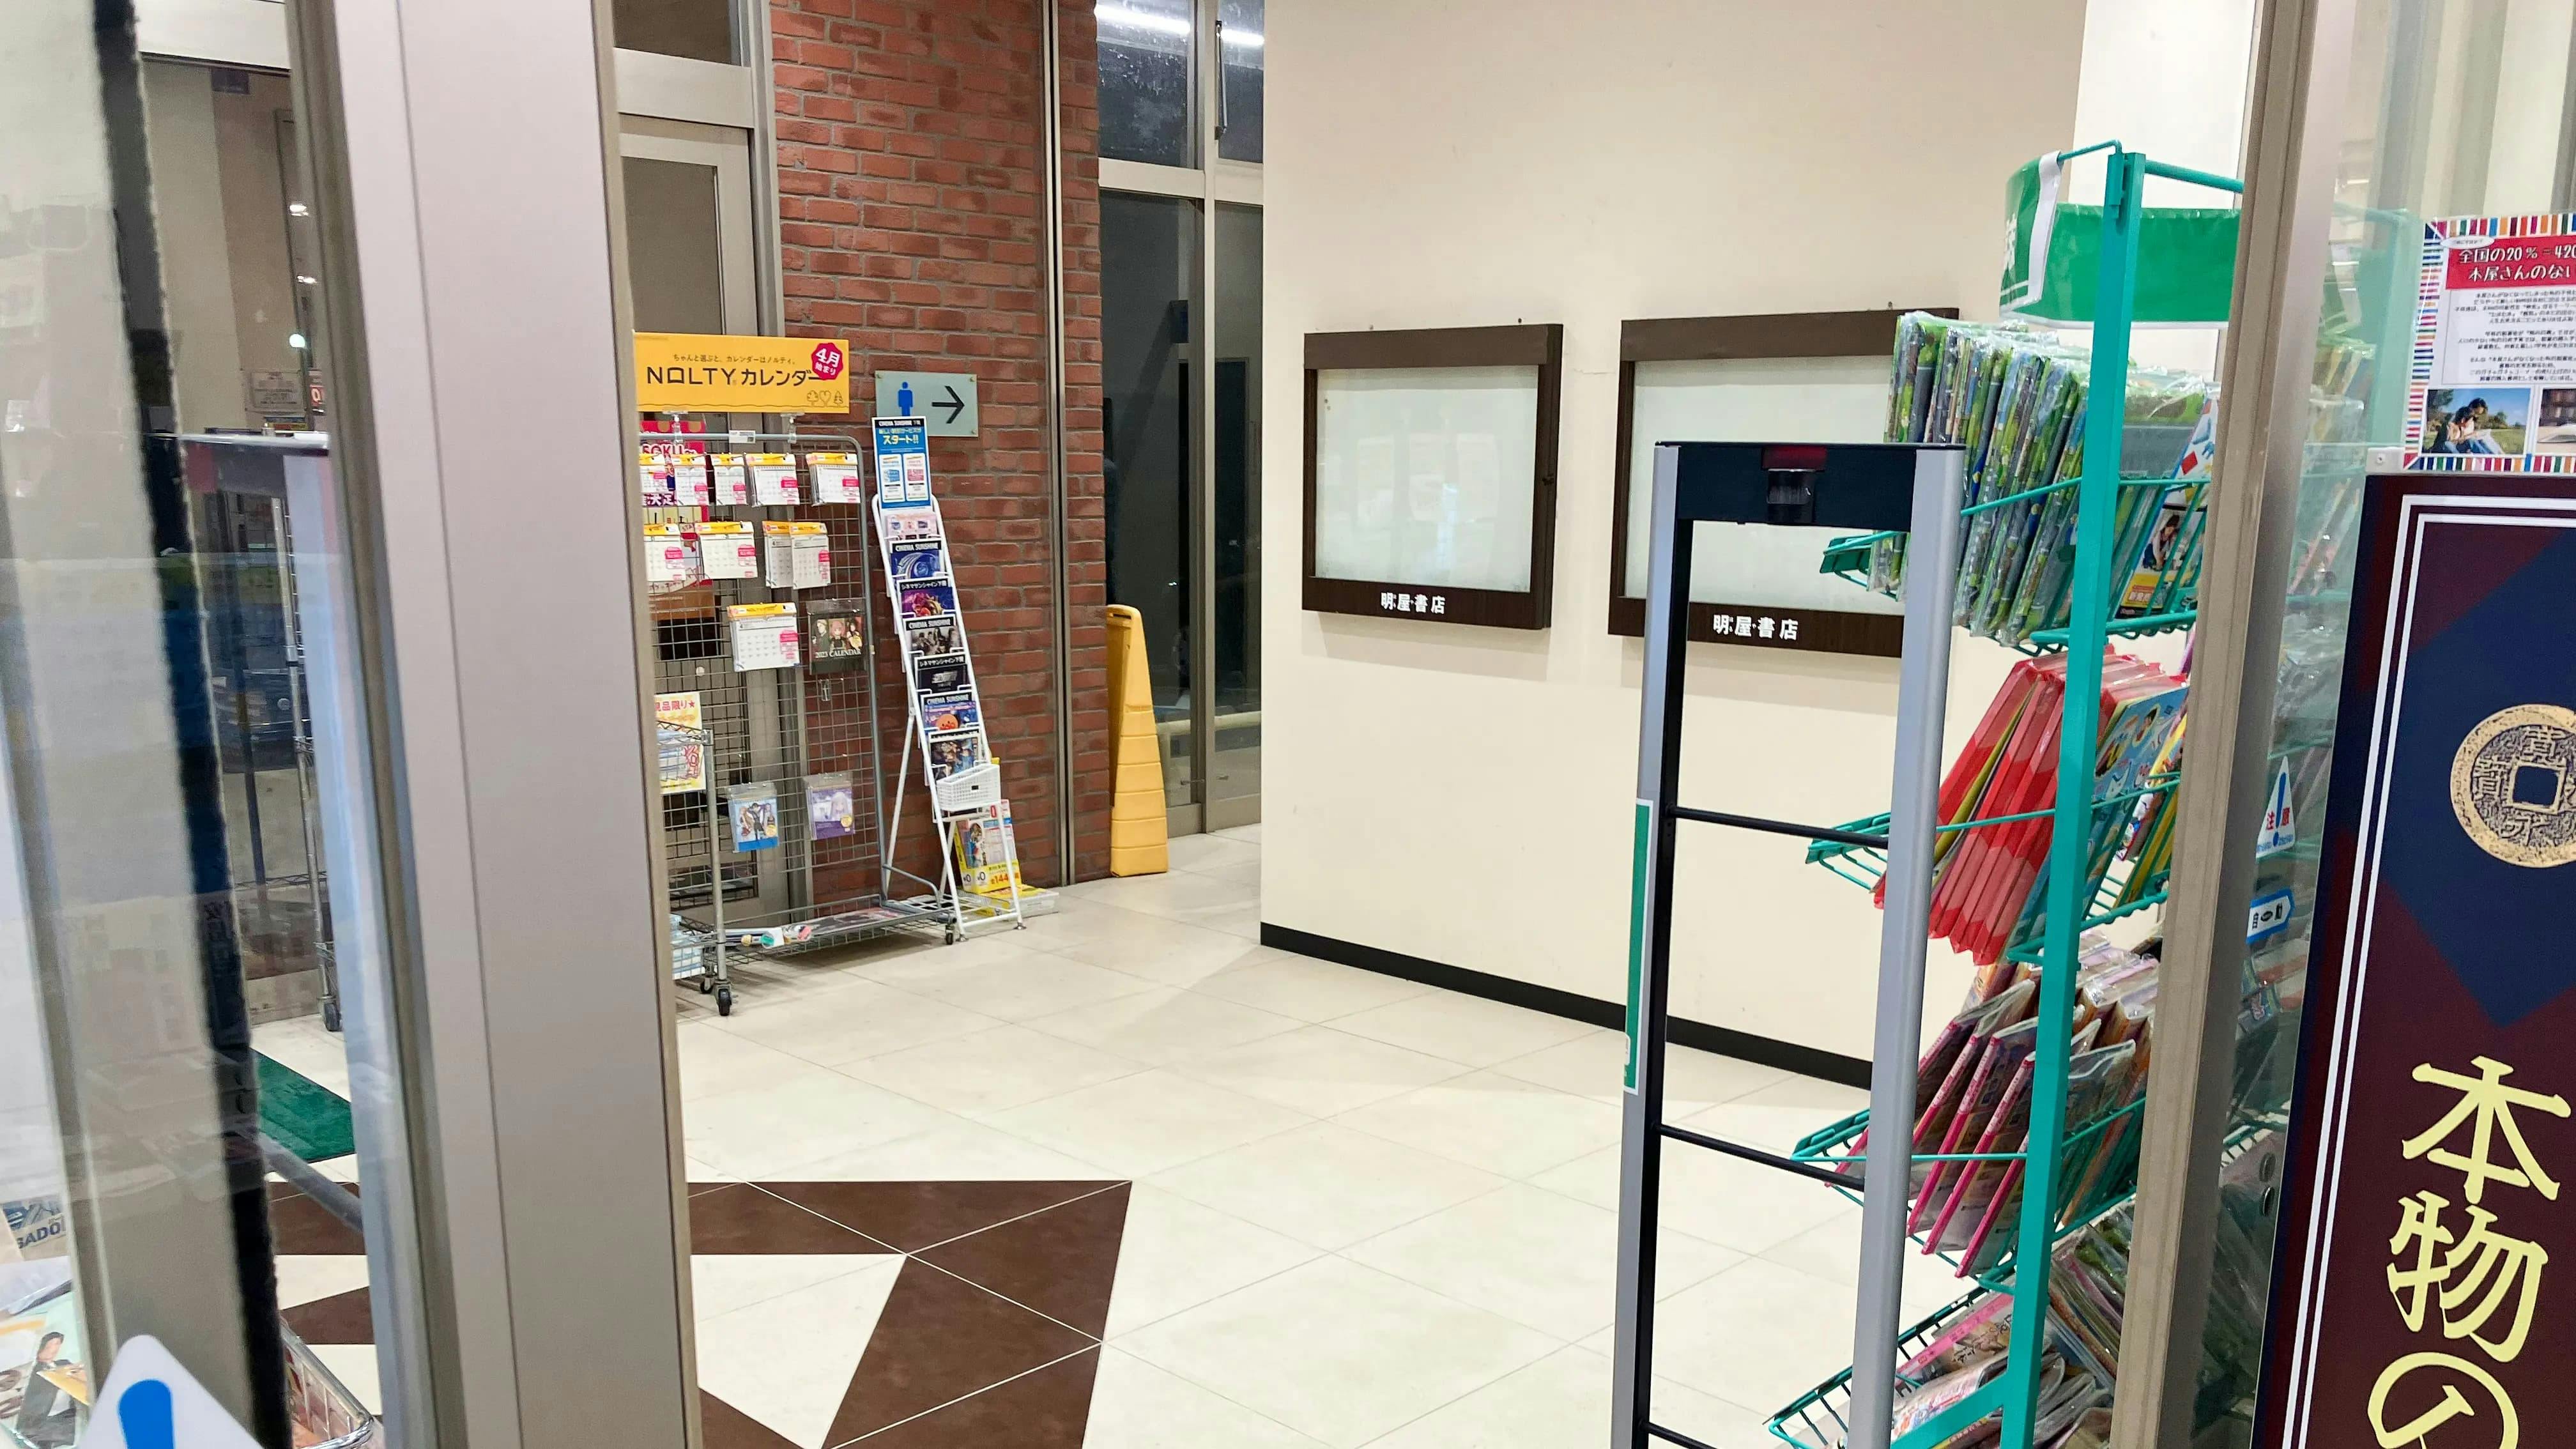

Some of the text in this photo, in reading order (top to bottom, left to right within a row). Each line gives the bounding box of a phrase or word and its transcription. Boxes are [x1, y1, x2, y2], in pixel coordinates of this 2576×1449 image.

[816, 348, 841, 367] 4月
[647, 367, 821, 387] NOLTY カレンダー
[815, 362, 836, 376] 始まり
[1381, 592, 1446, 615] 明屋書店
[1713, 614, 1799, 641] 明屋書店
[2367, 1055, 2572, 1449] 本物の
